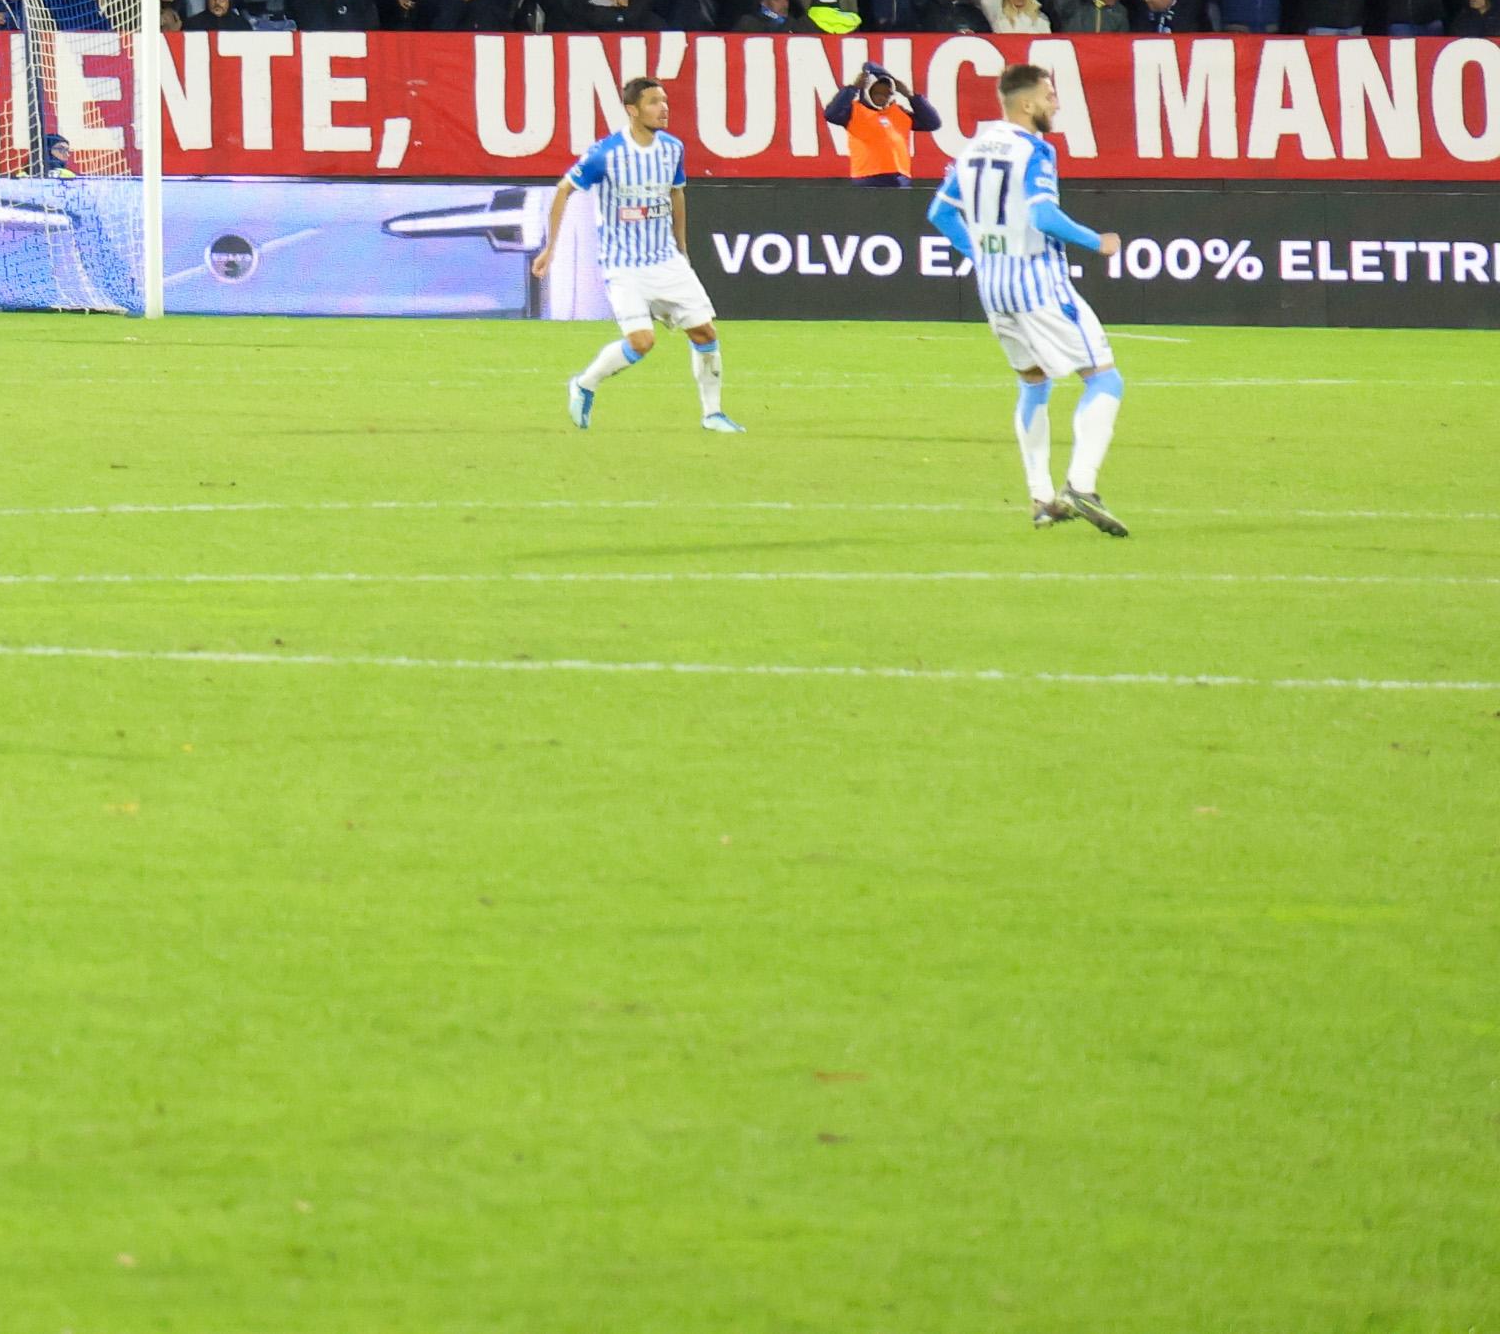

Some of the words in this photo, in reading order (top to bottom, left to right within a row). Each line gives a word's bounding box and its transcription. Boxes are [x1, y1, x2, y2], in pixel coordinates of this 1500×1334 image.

[1133, 36, 1500, 162] MANO
[967, 157, 1013, 226] 77
[711, 234, 903, 278] VOLVO
[1109, 237, 1264, 281] 100%
